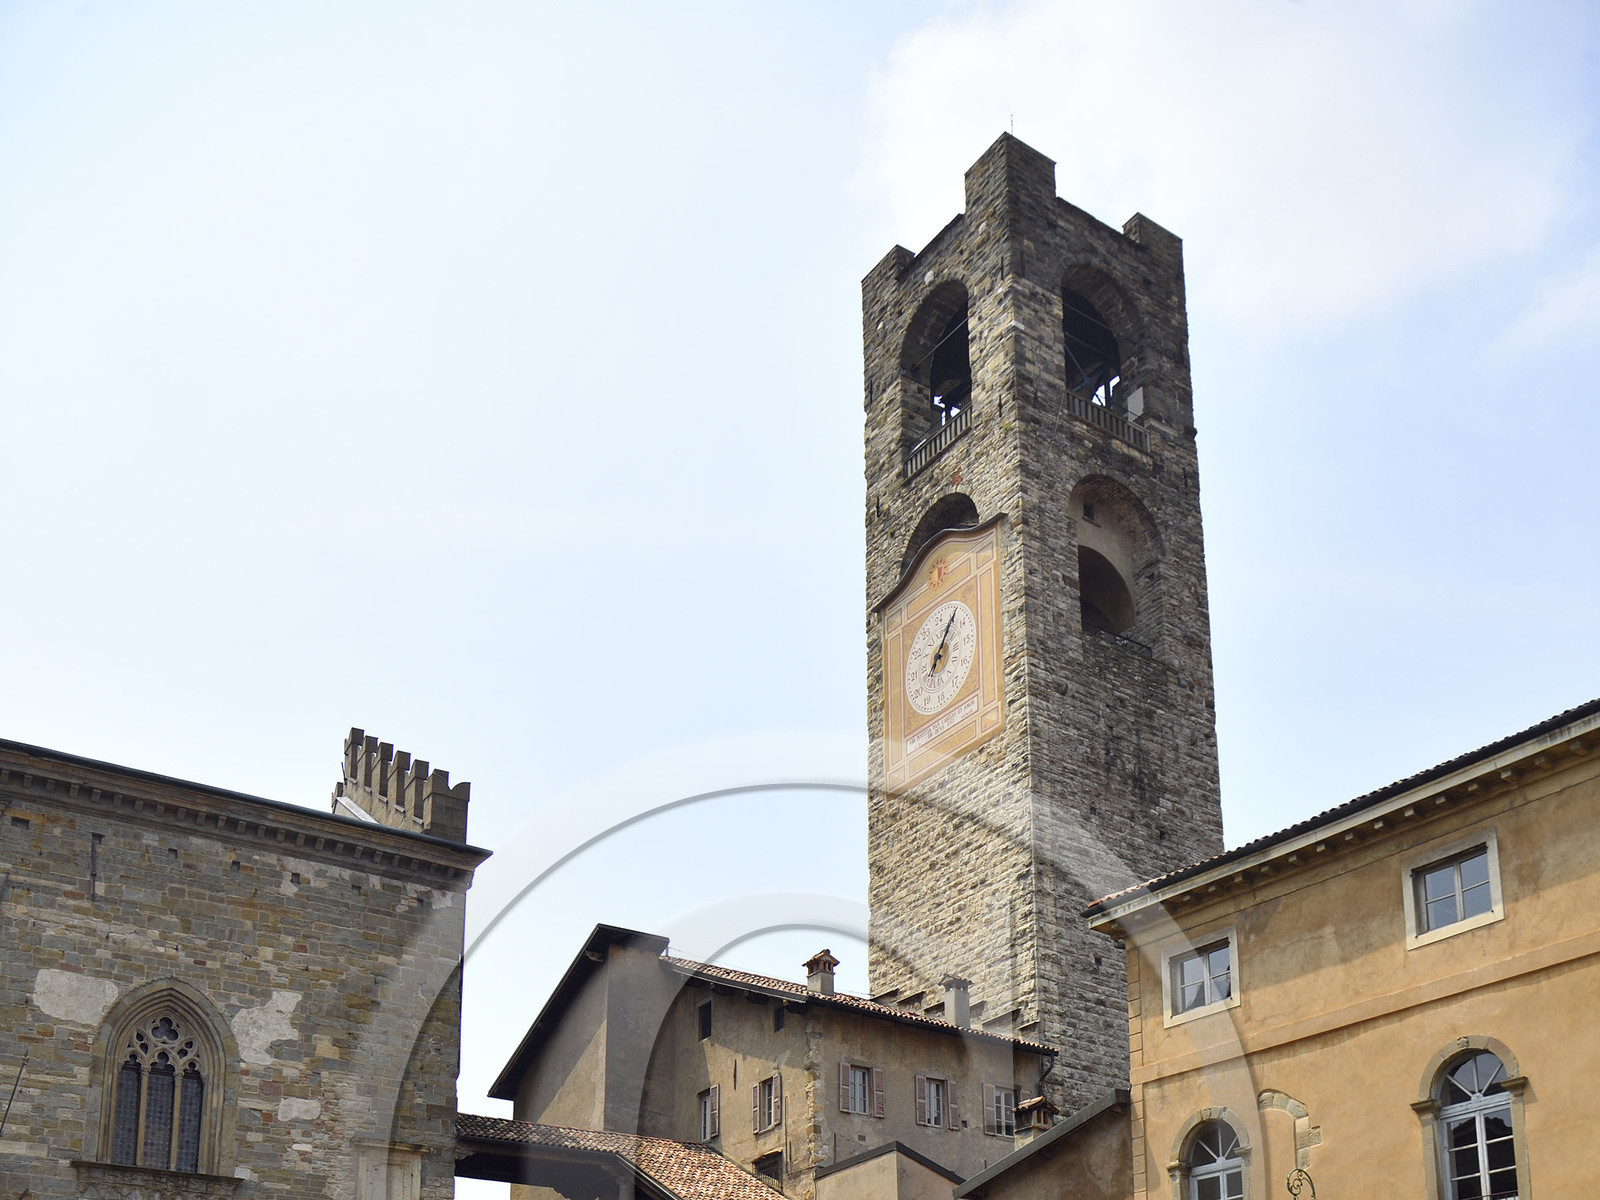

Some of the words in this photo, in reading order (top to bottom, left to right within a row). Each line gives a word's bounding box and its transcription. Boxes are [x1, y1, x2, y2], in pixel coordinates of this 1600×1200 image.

[959, 617, 966, 628] 14
[963, 633, 971, 646] 15
[961, 655, 968, 667] 16
[952, 675, 959, 688] 17
[923, 694, 931, 706] 19
[937, 692, 945, 703] 18
